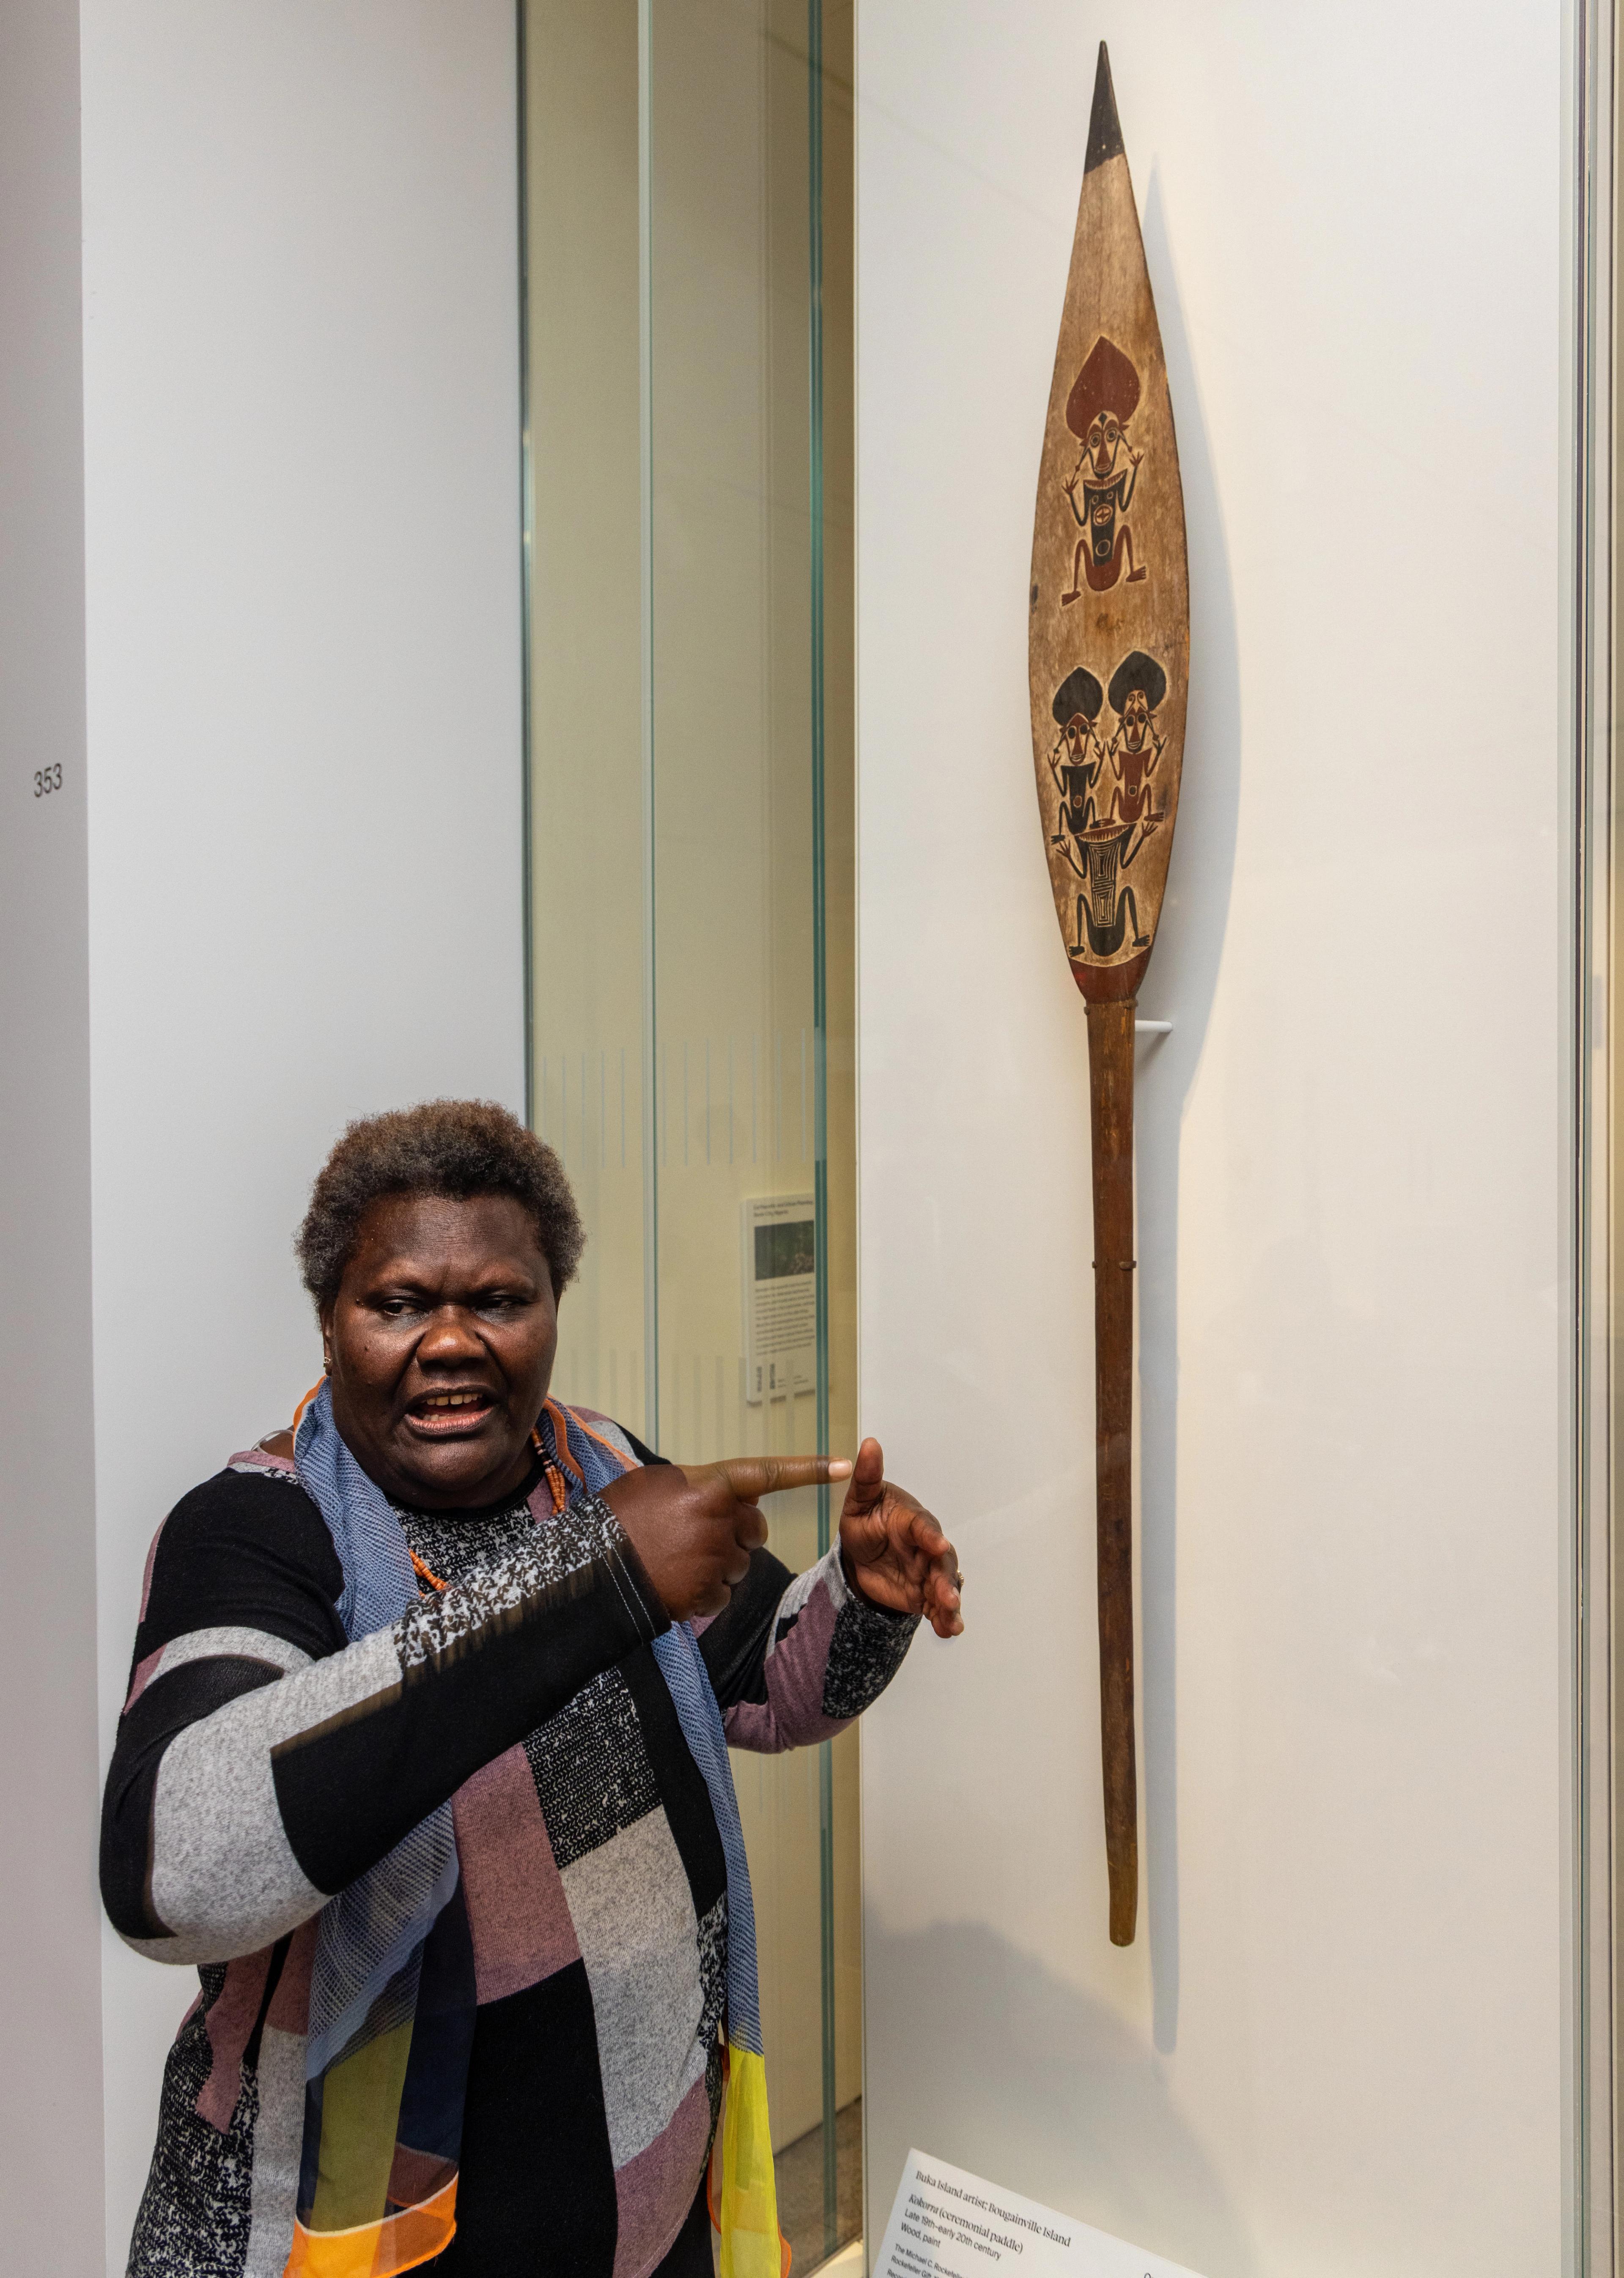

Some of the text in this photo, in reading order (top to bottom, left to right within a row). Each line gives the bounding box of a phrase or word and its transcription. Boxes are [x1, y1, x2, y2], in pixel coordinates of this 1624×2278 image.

[34, 763, 62, 797] 353
[909, 2193, 1023, 2255] Kokorra (ceremonial paddle)
[916, 2171, 1071, 2247] Buka Island artist; Bougainville Island
[901, 2222, 941, 2248] Wood, paint
[905, 2208, 919, 2221] Late
[956, 2232, 973, 2247] 20th
[974, 2242, 1001, 2261] century
[891, 2255, 921, 2275] Rockefeller
[895, 2243, 905, 2254] The
[905, 2248, 927, 2265] Michael
[934, 2262, 963, 2278] Rockefell
